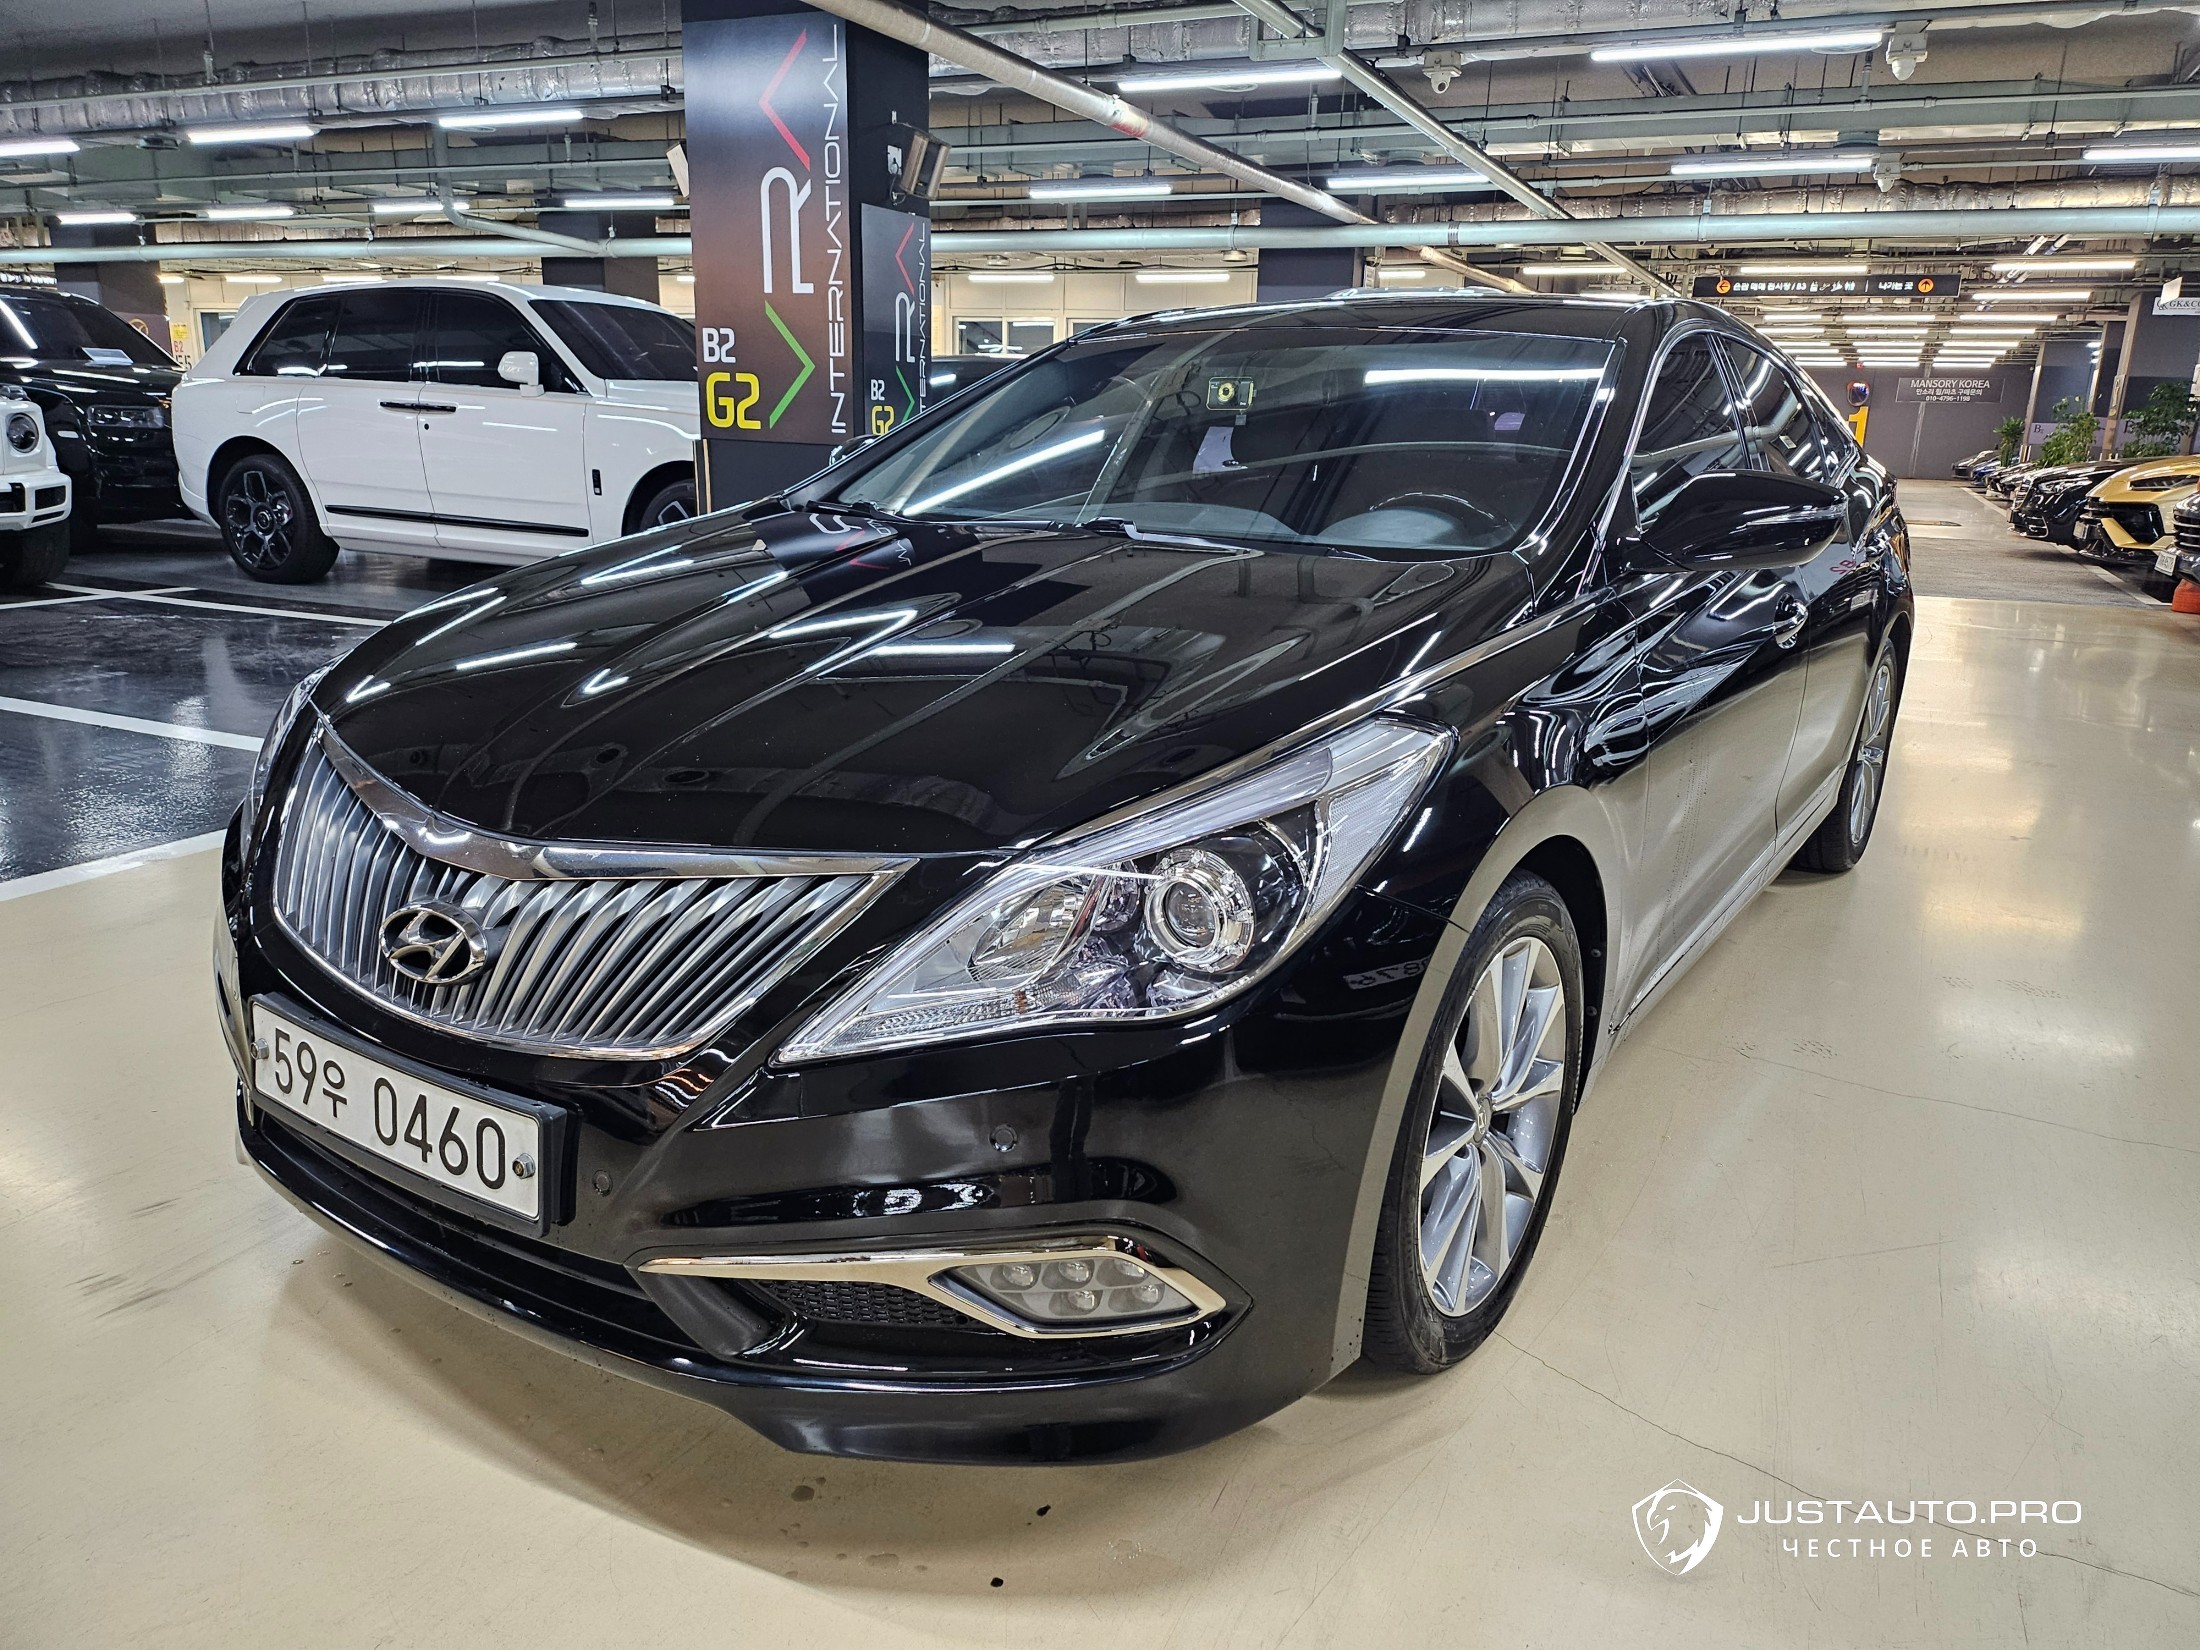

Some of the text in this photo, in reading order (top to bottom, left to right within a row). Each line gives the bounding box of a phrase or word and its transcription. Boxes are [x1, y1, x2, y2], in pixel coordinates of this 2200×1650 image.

[822, 24, 847, 434] INTERNATIONAL
[918, 222, 927, 413] TERNATIONAL
[702, 327, 737, 364] B2
[705, 371, 761, 430] G2
[870, 379, 885, 401] B2
[1910, 379, 1990, 388] MANSORY KOREA
[871, 405, 895, 436] G2
[274, 1027, 506, 1190] 59우 0460
